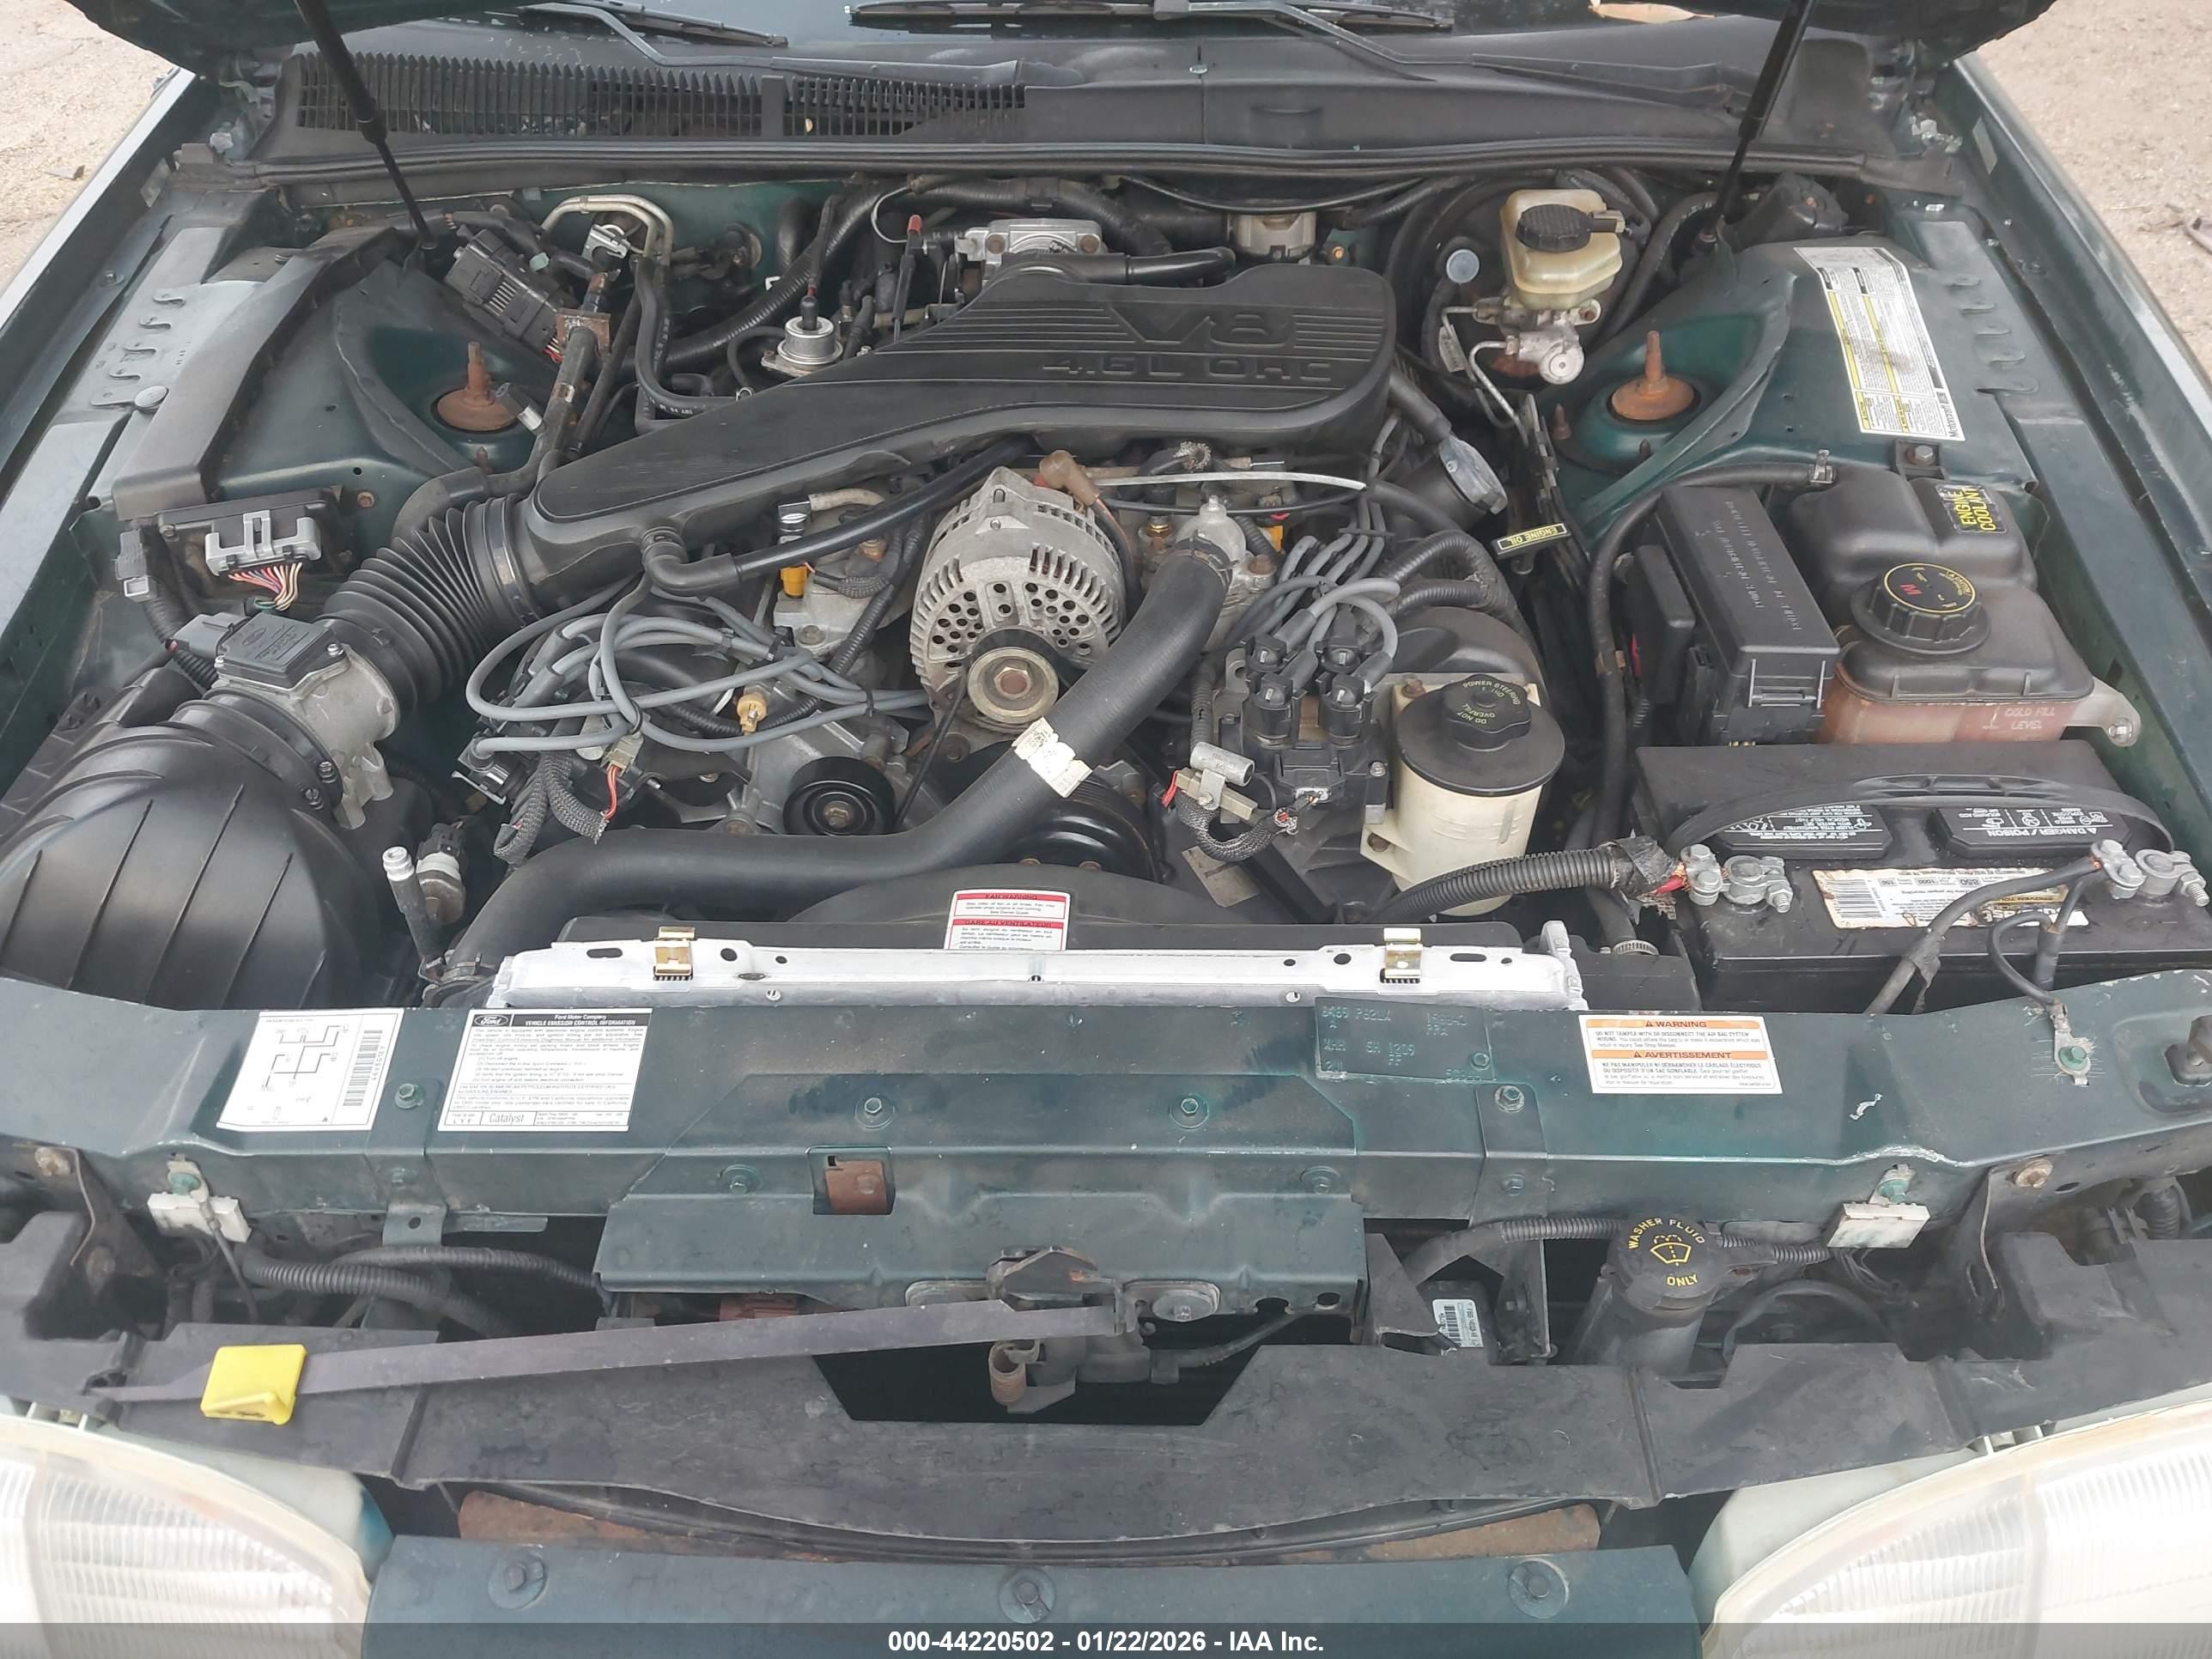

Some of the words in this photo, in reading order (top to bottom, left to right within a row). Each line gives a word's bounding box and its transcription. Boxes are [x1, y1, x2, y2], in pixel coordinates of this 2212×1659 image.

[1109, 305, 1287, 349] V8
[1948, 489, 1978, 526] ENGINE
[1507, 536, 1523, 545] OIL
[1525, 526, 1558, 541] ENGINE
[1494, 682, 1521, 706] STEERING
[1457, 712, 1473, 721] NOT
[1463, 703, 1496, 718] OVERFILL
[479, 1016, 502, 1026] Ford
[489, 1113, 524, 1125] Catalyst
[1628, 1218, 1663, 1249] WASHER
[1668, 1219, 1705, 1244] FLUID
[1667, 1273, 1698, 1286] ONLY
